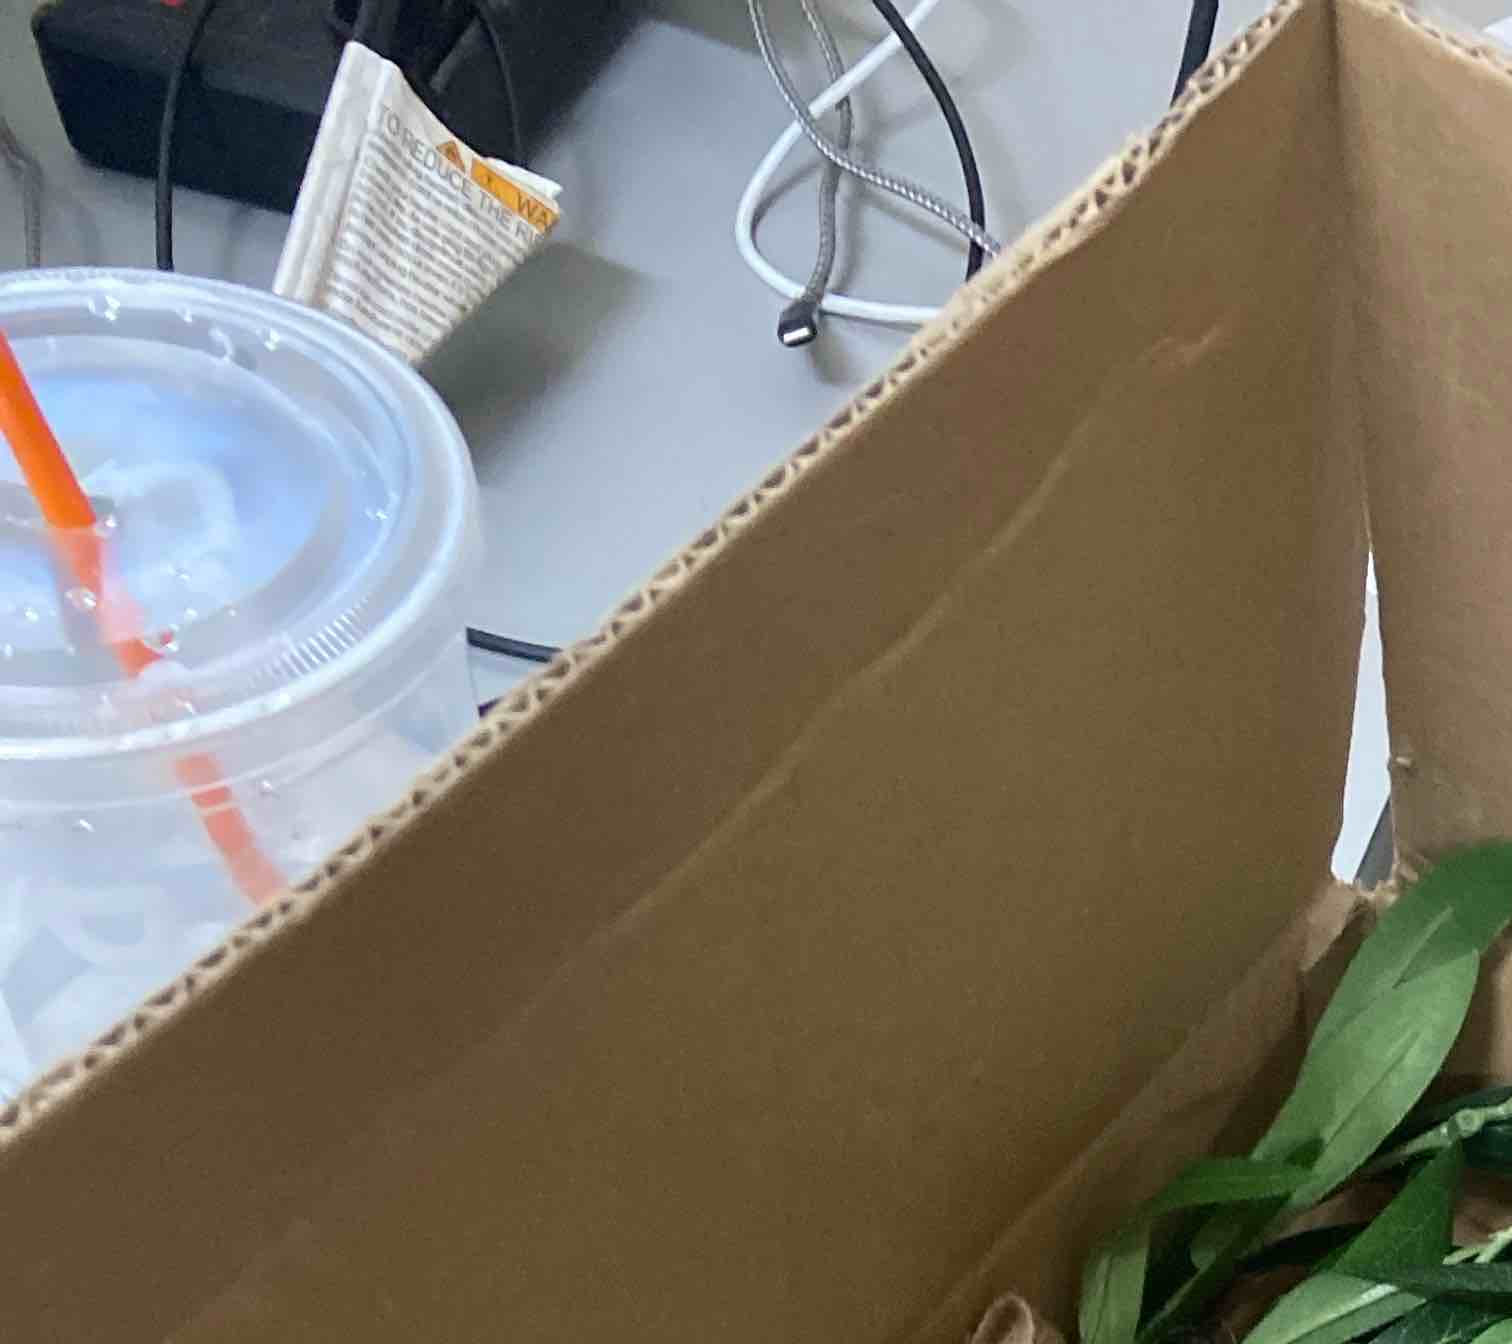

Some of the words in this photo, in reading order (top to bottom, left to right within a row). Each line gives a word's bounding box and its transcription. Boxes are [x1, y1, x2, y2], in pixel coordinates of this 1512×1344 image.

[380, 104, 401, 138] TO
[402, 127, 472, 200] REDUCE
[478, 189, 513, 230] THE
